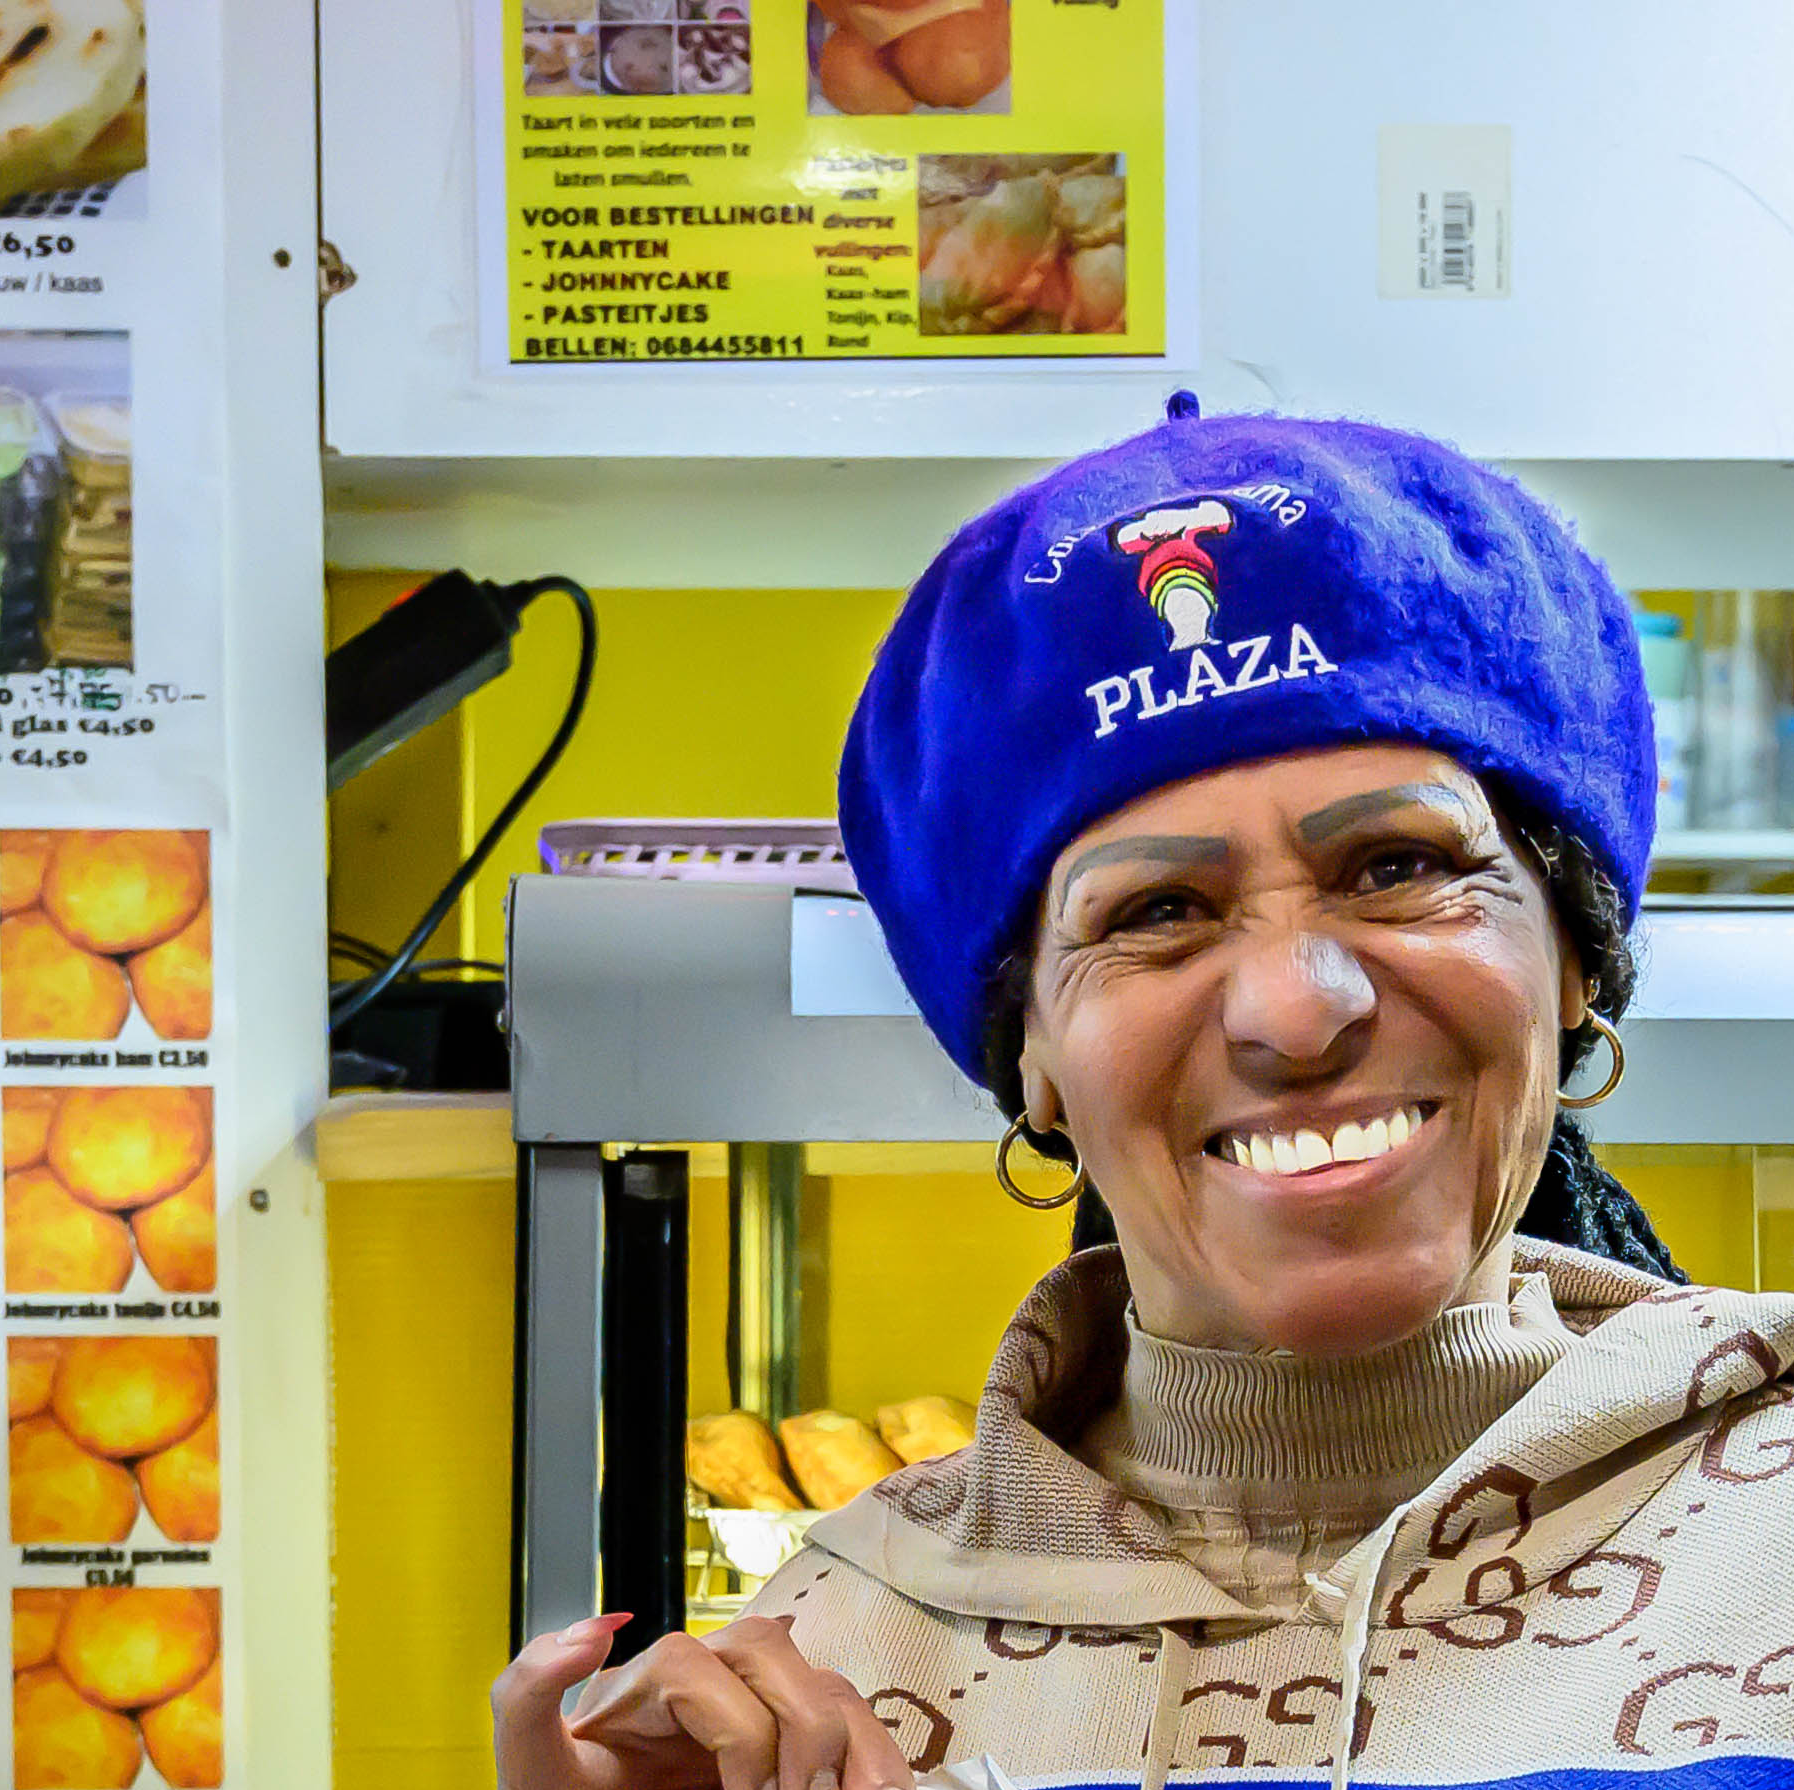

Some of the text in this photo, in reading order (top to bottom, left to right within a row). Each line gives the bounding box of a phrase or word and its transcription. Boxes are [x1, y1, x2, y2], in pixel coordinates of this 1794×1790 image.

[522, 204, 815, 227] VOOR BESTELLINGEN
[541, 239, 670, 259] TAARTEN
[541, 270, 732, 292] JOHNNYCAKE
[542, 304, 710, 324] PASTEITJES
[1085, 622, 1339, 740] PLAZA
